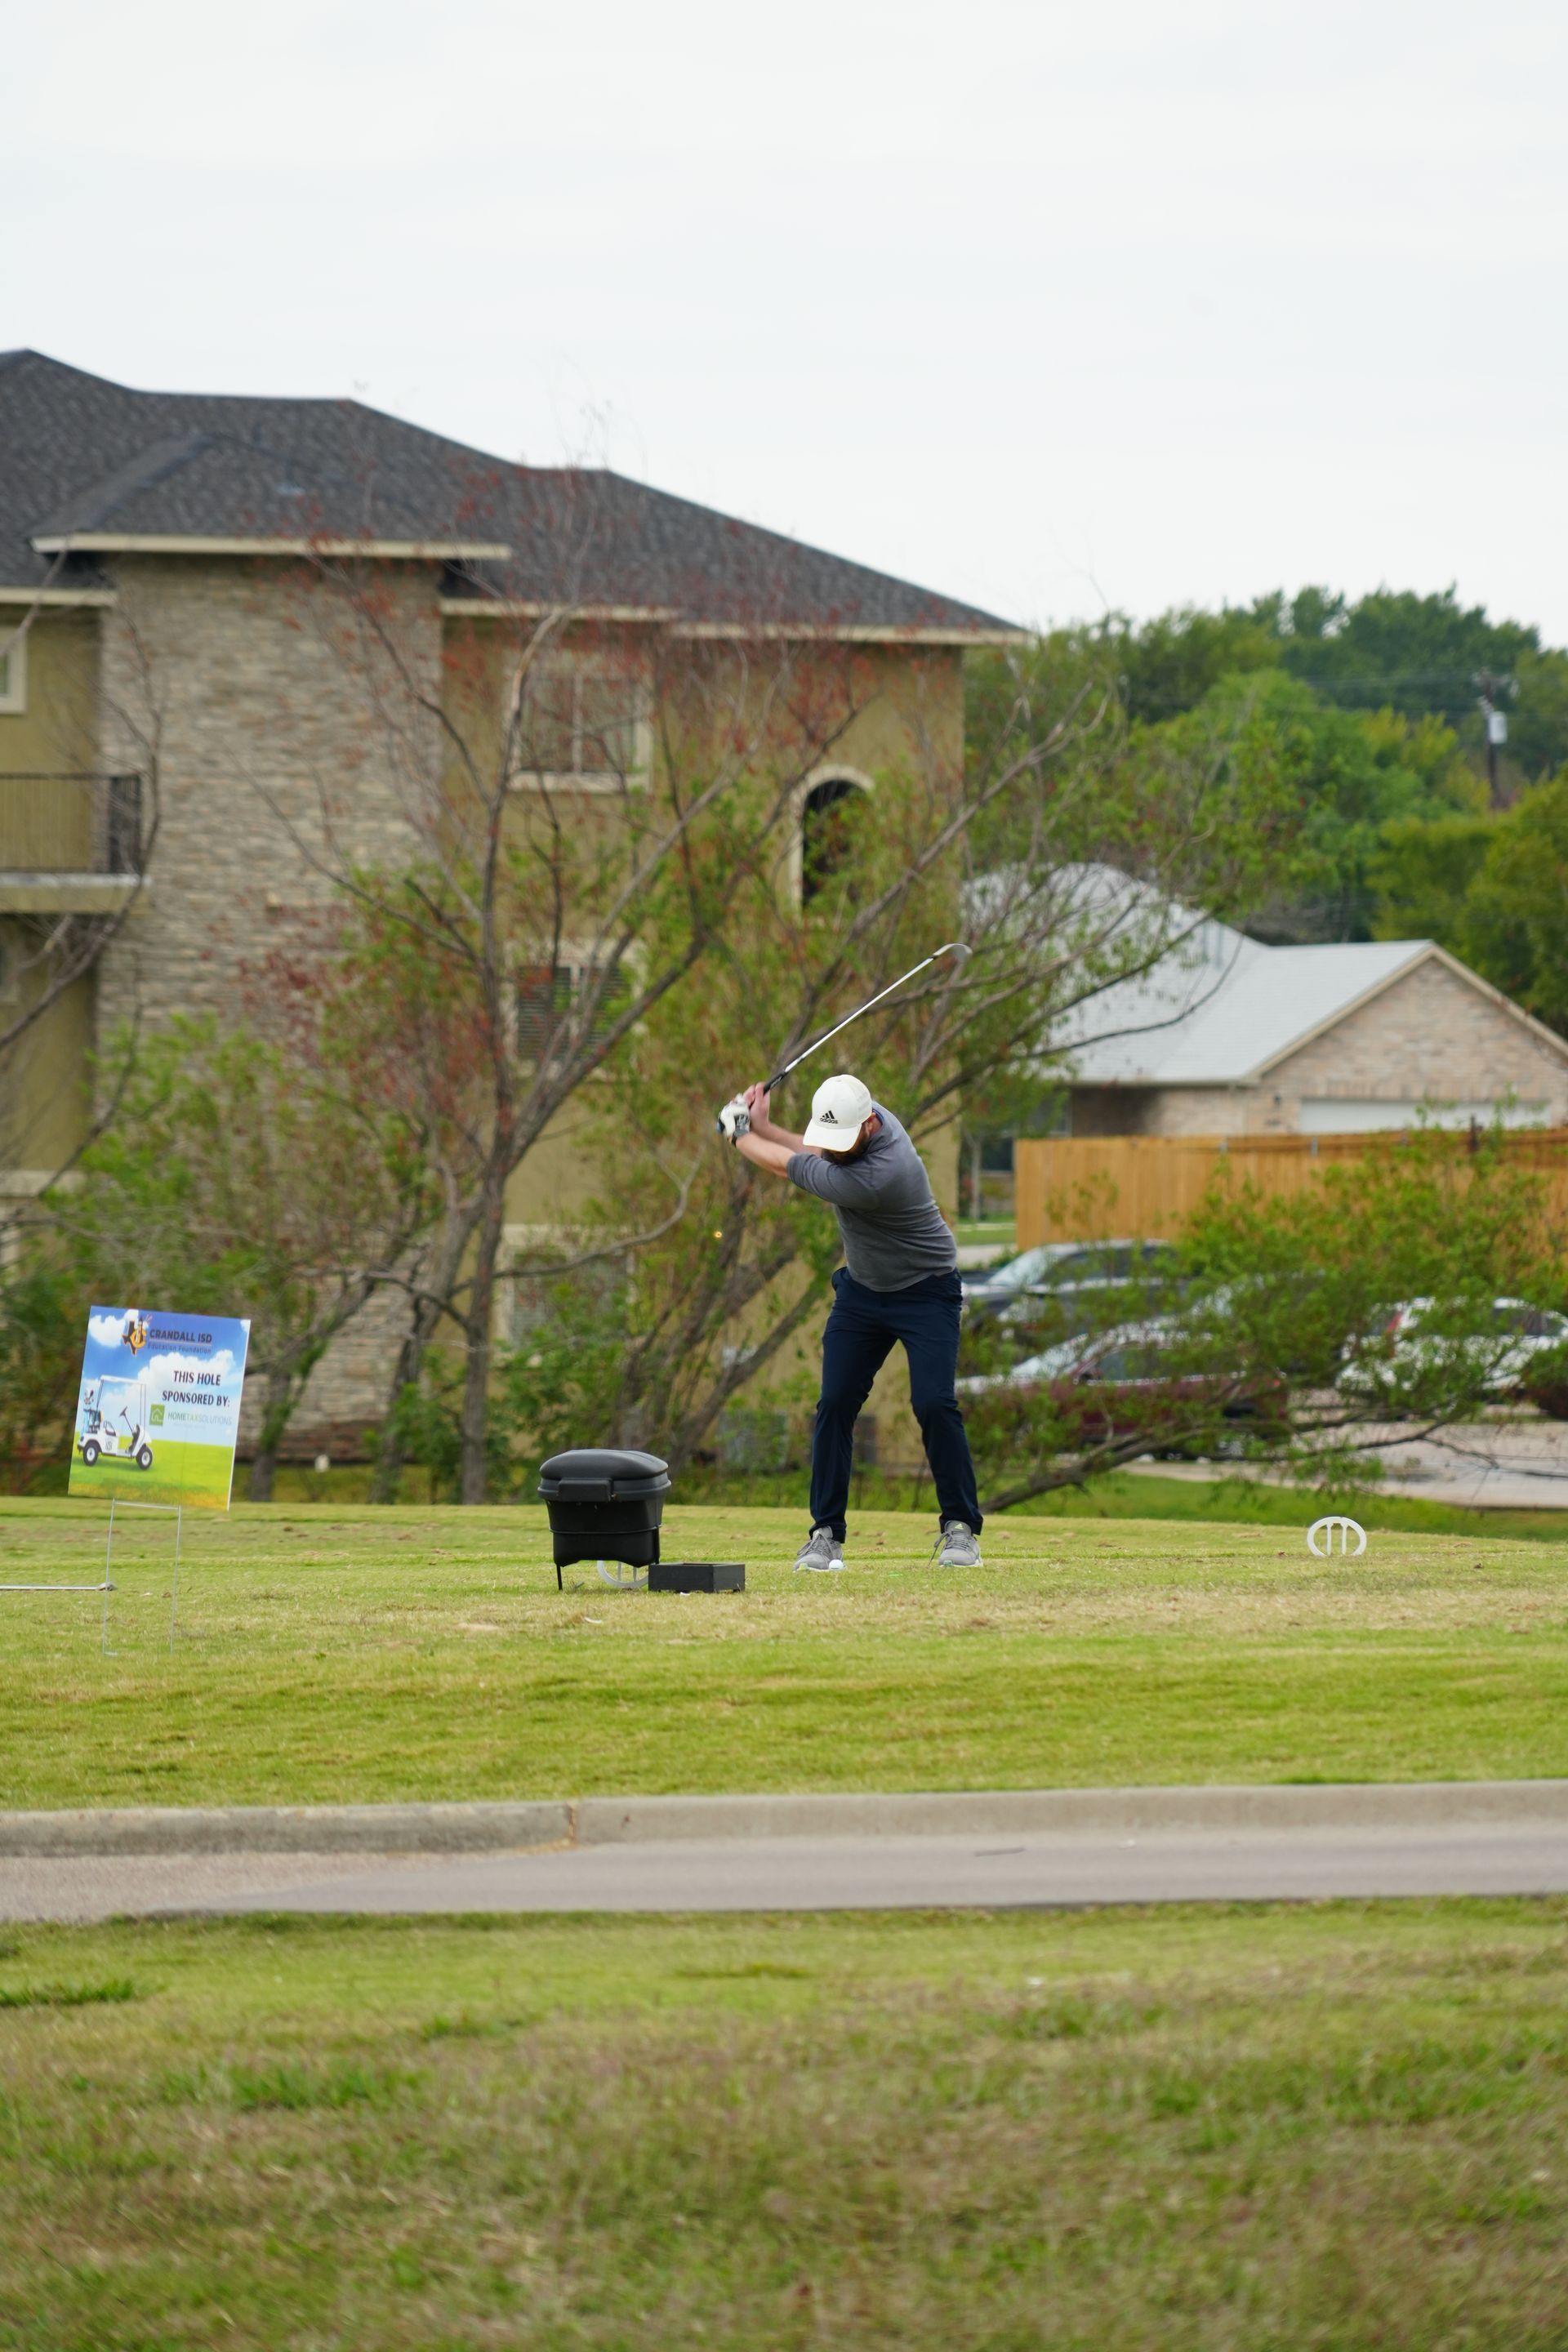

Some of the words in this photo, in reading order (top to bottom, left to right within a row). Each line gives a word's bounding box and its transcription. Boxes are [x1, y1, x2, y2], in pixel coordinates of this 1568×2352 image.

[149, 1329, 195, 1342] CRANDALL
[198, 1333, 212, 1343] ISD
[148, 1343, 176, 1352] Education
[178, 1346, 212, 1354] Foundation
[173, 1370, 194, 1383] THIS
[197, 1373, 221, 1386] HOLE
[162, 1390, 214, 1405] SPONSORED
[216, 1395, 230, 1407] BY:
